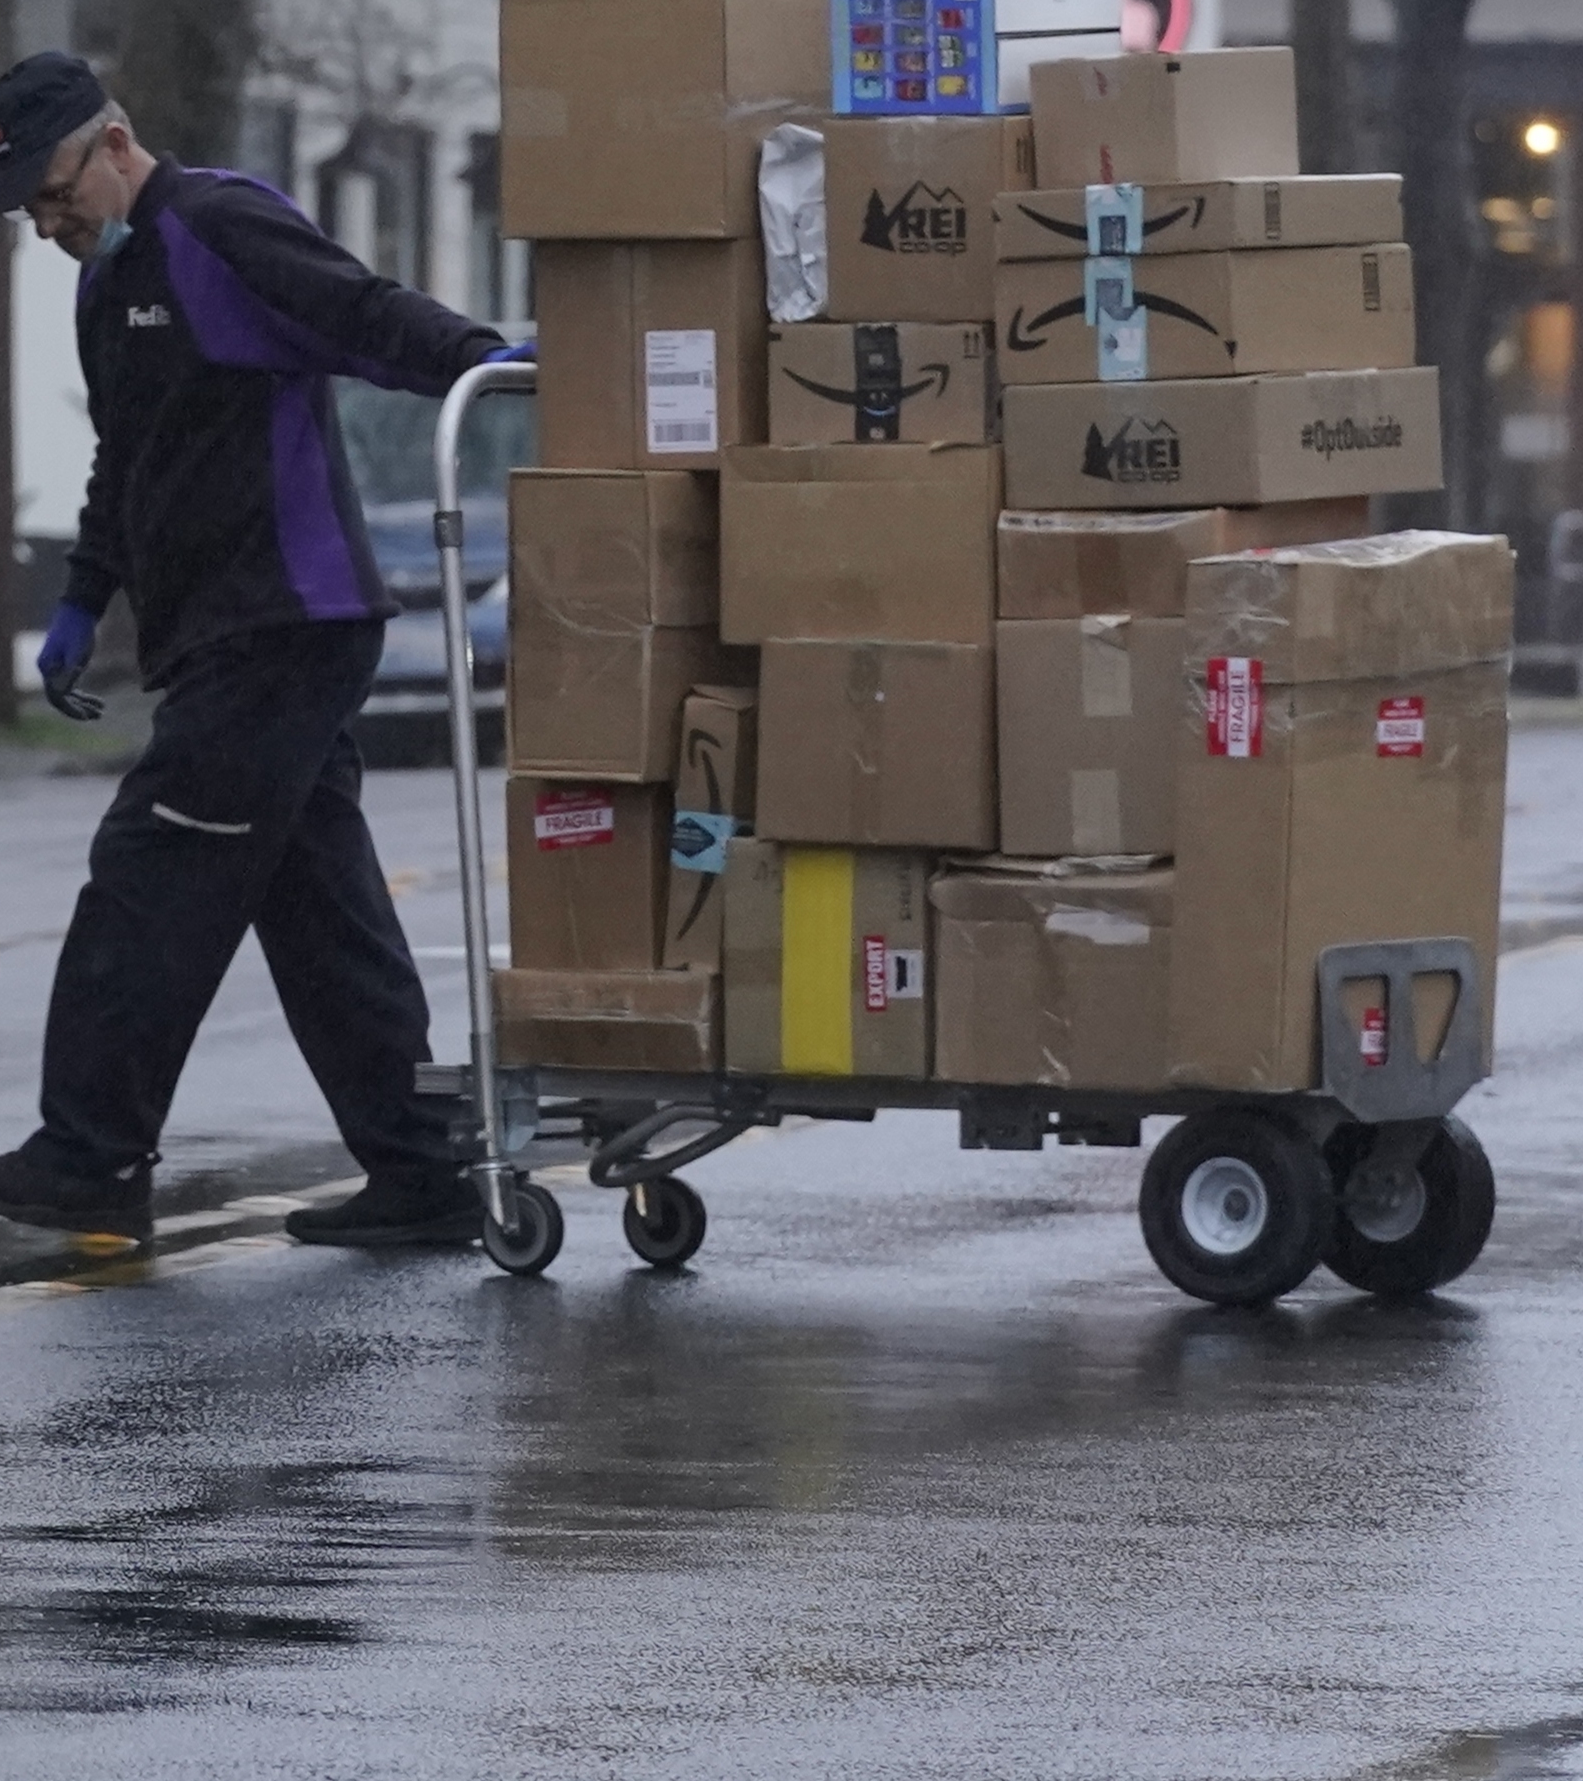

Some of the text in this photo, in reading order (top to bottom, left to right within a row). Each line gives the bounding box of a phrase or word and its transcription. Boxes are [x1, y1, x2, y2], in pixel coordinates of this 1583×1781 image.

[898, 206, 966, 239] REI
[1117, 439, 1181, 468] REI
[1300, 415, 1403, 462] #OptOutside
[1230, 672, 1245, 743] FRAGILE
[545, 810, 602, 832] FRAGILE
[866, 940, 885, 1008] EXPORT
